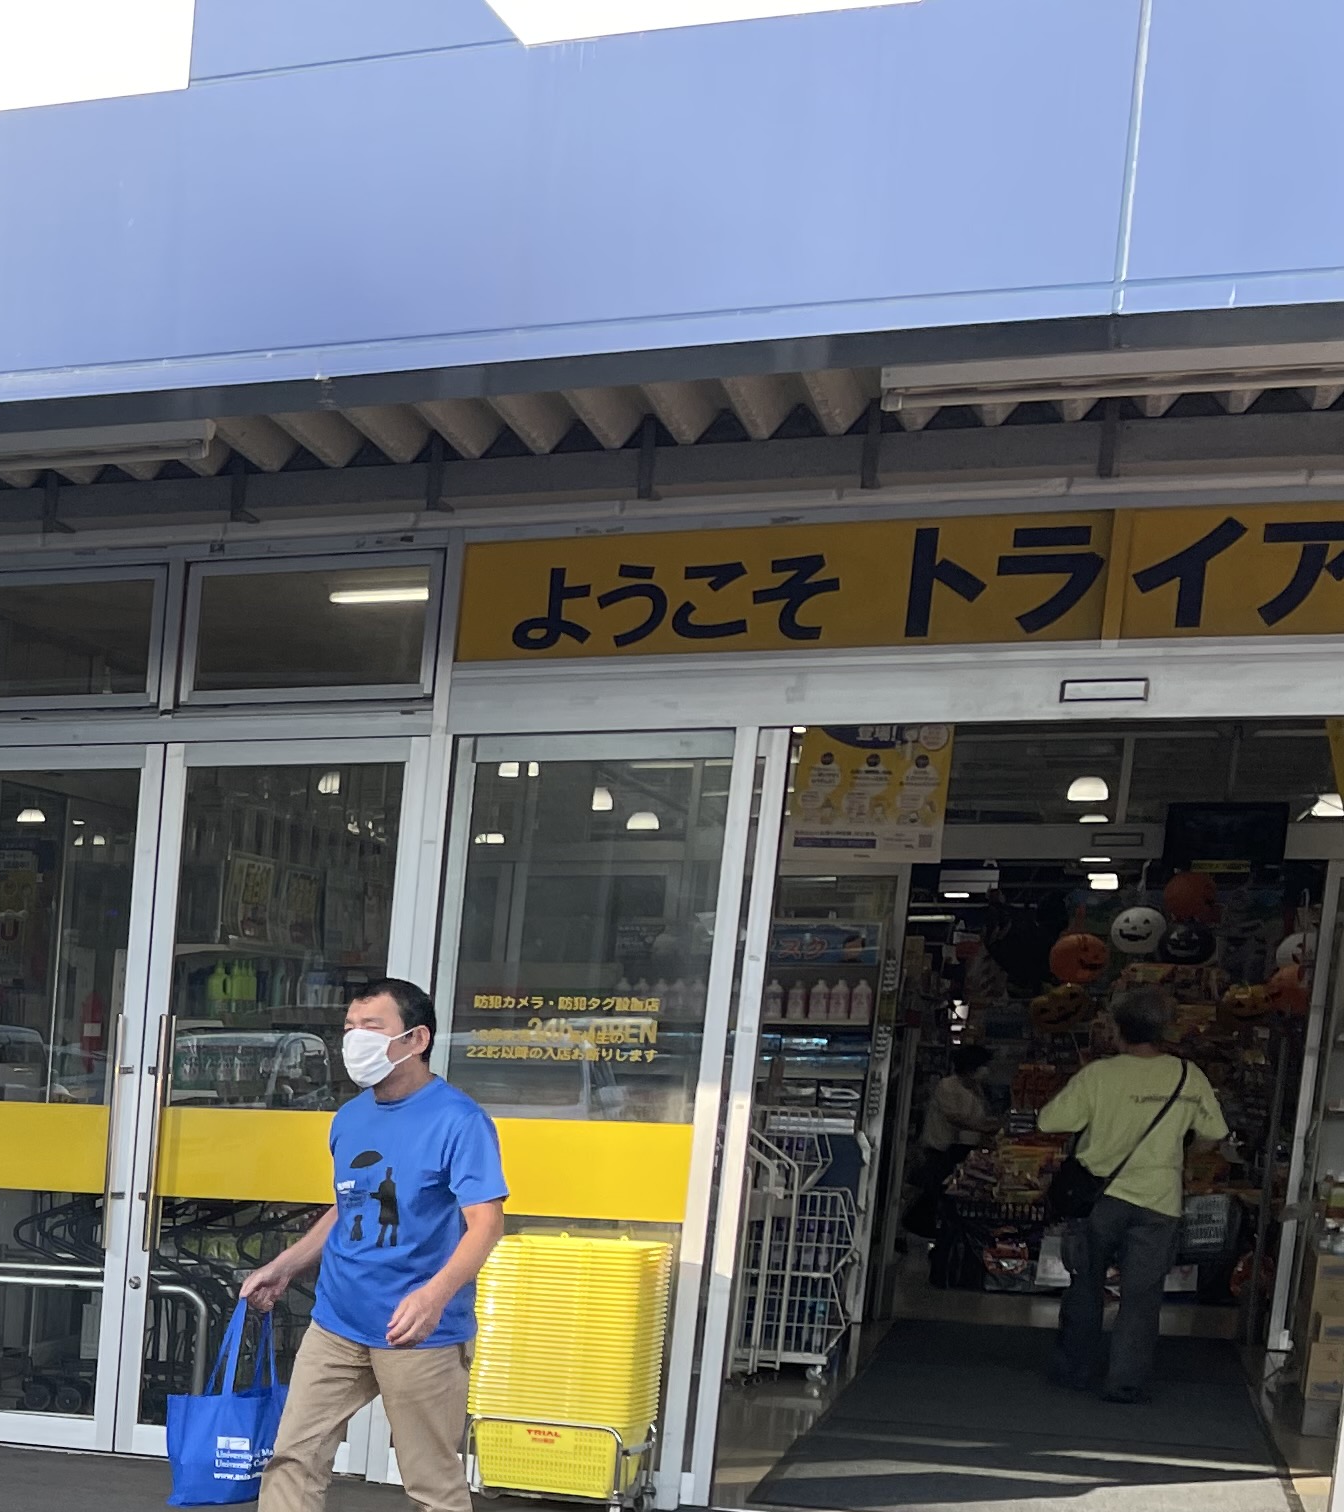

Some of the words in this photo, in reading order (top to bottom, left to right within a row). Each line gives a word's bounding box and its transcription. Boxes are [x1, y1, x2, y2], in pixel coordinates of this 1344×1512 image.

[511, 553, 841, 651] ようこそ
[526, 1428, 562, 1439] TRIAL
[215, 1449, 253, 1462] University
